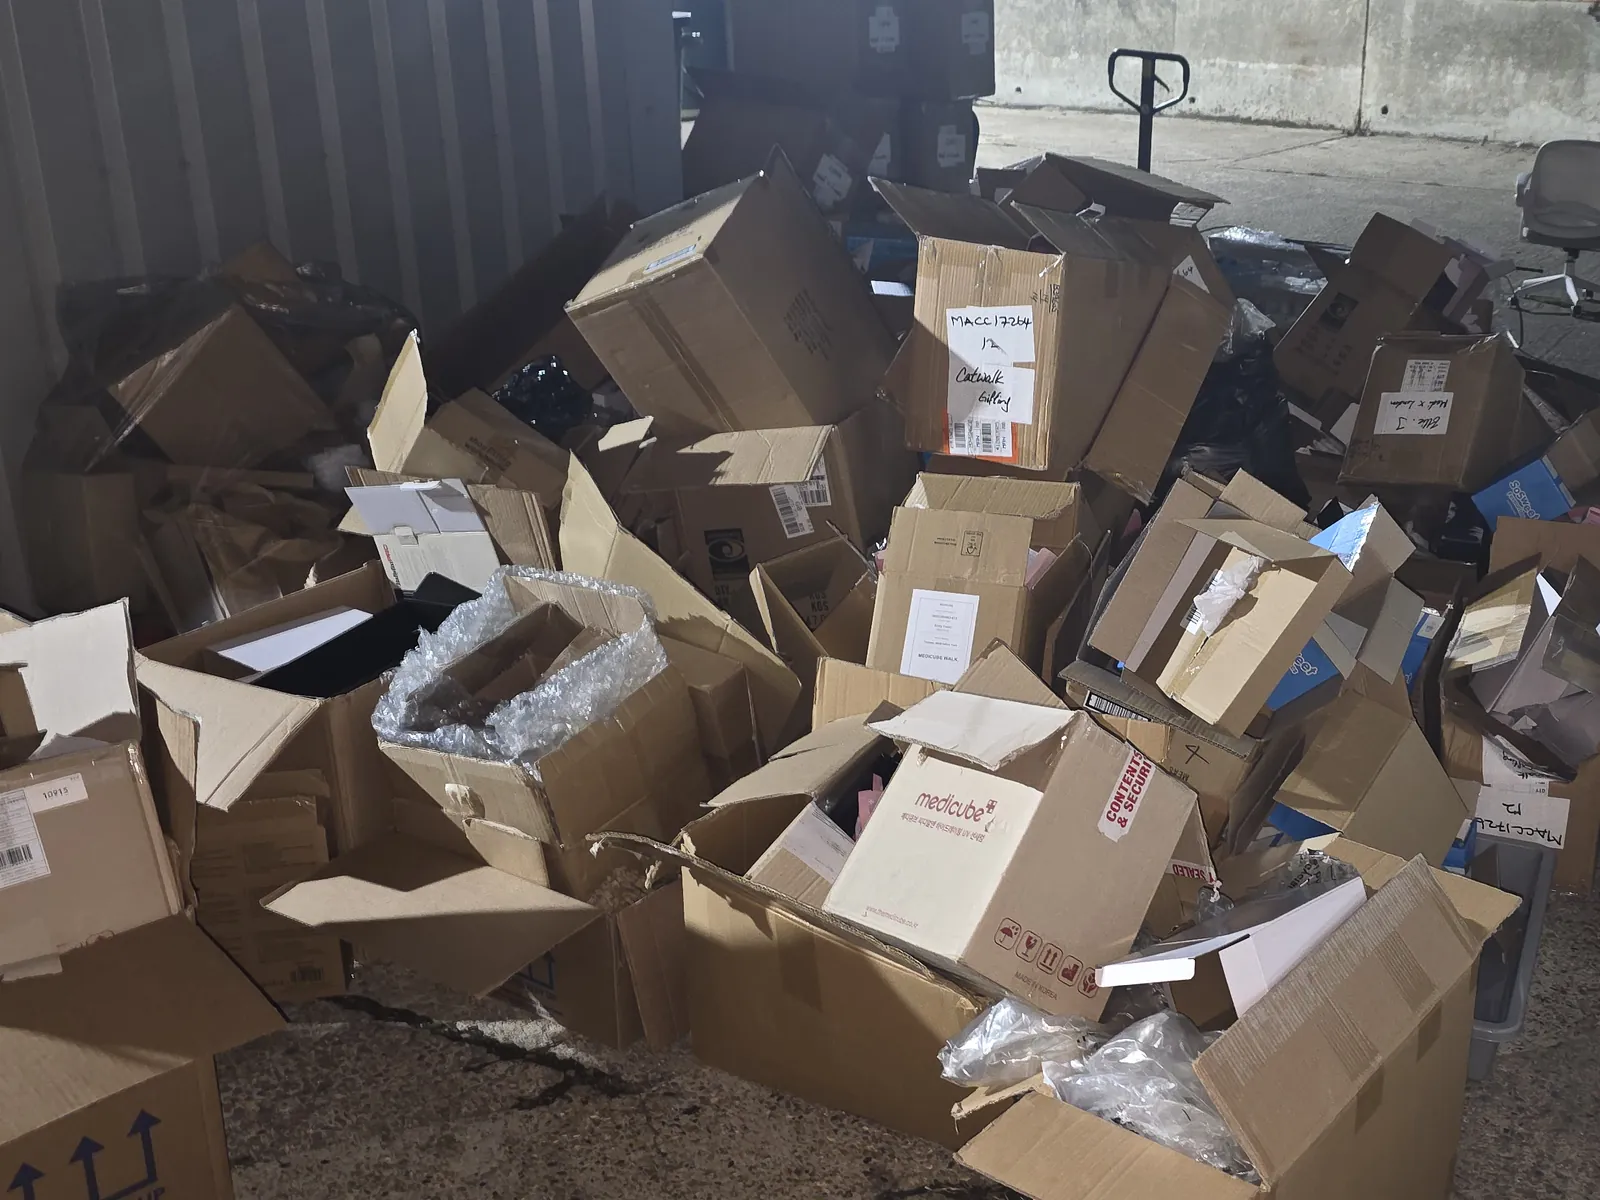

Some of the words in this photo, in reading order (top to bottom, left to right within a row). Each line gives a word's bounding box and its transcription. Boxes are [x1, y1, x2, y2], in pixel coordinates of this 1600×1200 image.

[951, 315, 1032, 330] MACC17264
[955, 367, 1004, 384] Catwalk
[1508, 479, 1540, 519] SoSweet
[918, 653, 943, 661] MEDICUBE
[1294, 653, 1318, 676] eet
[42, 786, 69, 800] 10915
[1106, 749, 1143, 822] CONTENTS
[914, 792, 985, 822] medicube
[1117, 816, 1129, 828] &
[1172, 863, 1207, 880] SEALED
[1014, 971, 1032, 987] MADE
[1037, 983, 1058, 1000] KOREA
